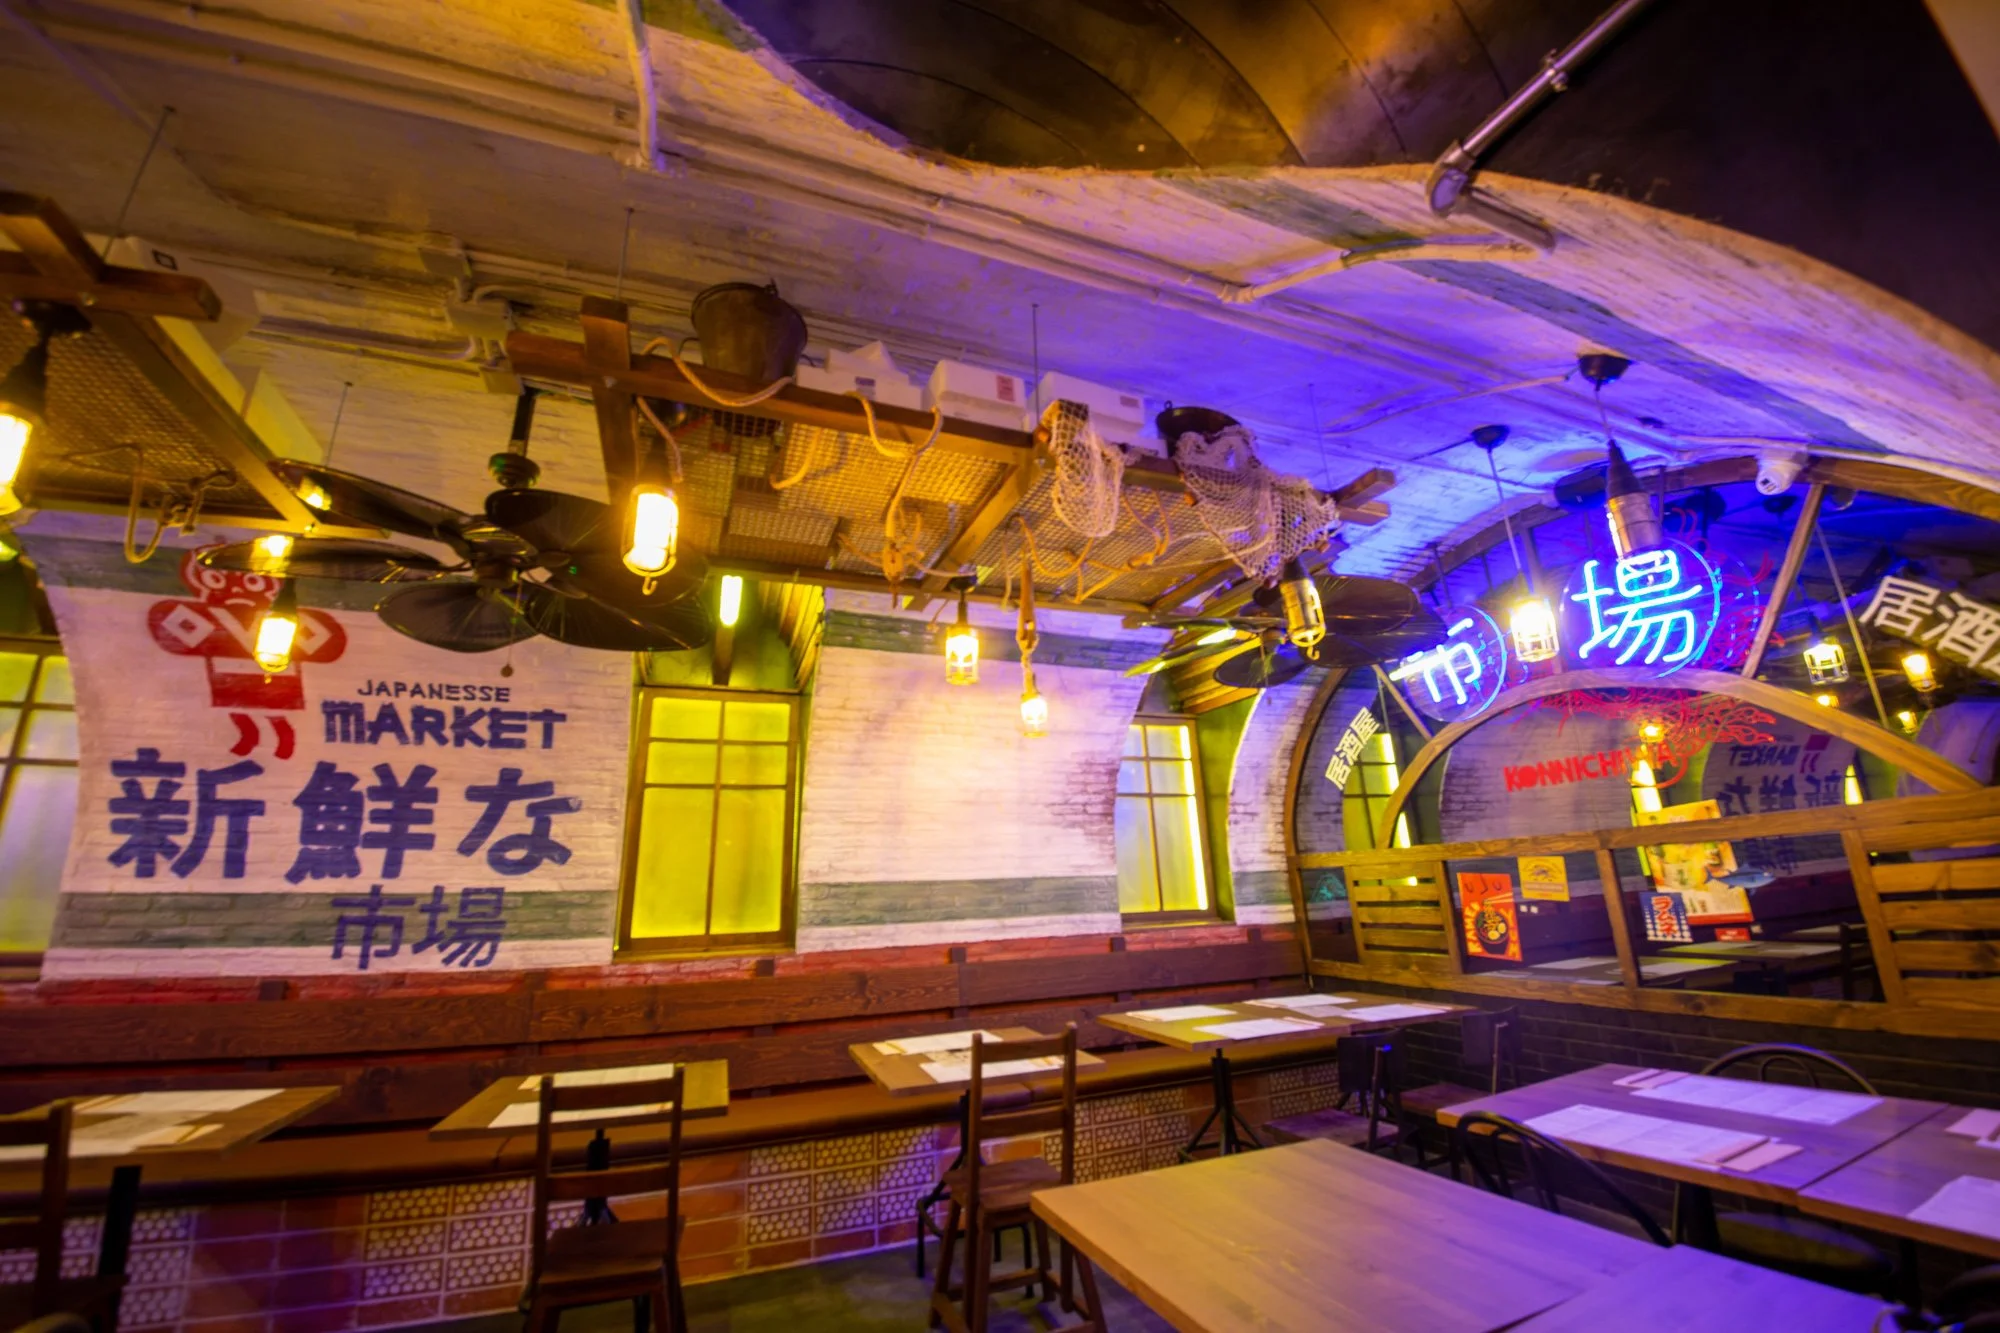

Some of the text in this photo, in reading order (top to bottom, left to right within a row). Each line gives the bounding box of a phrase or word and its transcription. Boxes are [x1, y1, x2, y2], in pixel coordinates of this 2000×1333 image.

[1389, 549, 1702, 705] 市 場
[1859, 575, 2000, 677] 居酒
[321, 700, 567, 749] MARKET
[357, 680, 510, 702] JAPANESSE
[109, 747, 580, 884] 新鮮な
[331, 884, 506, 969] 市場
